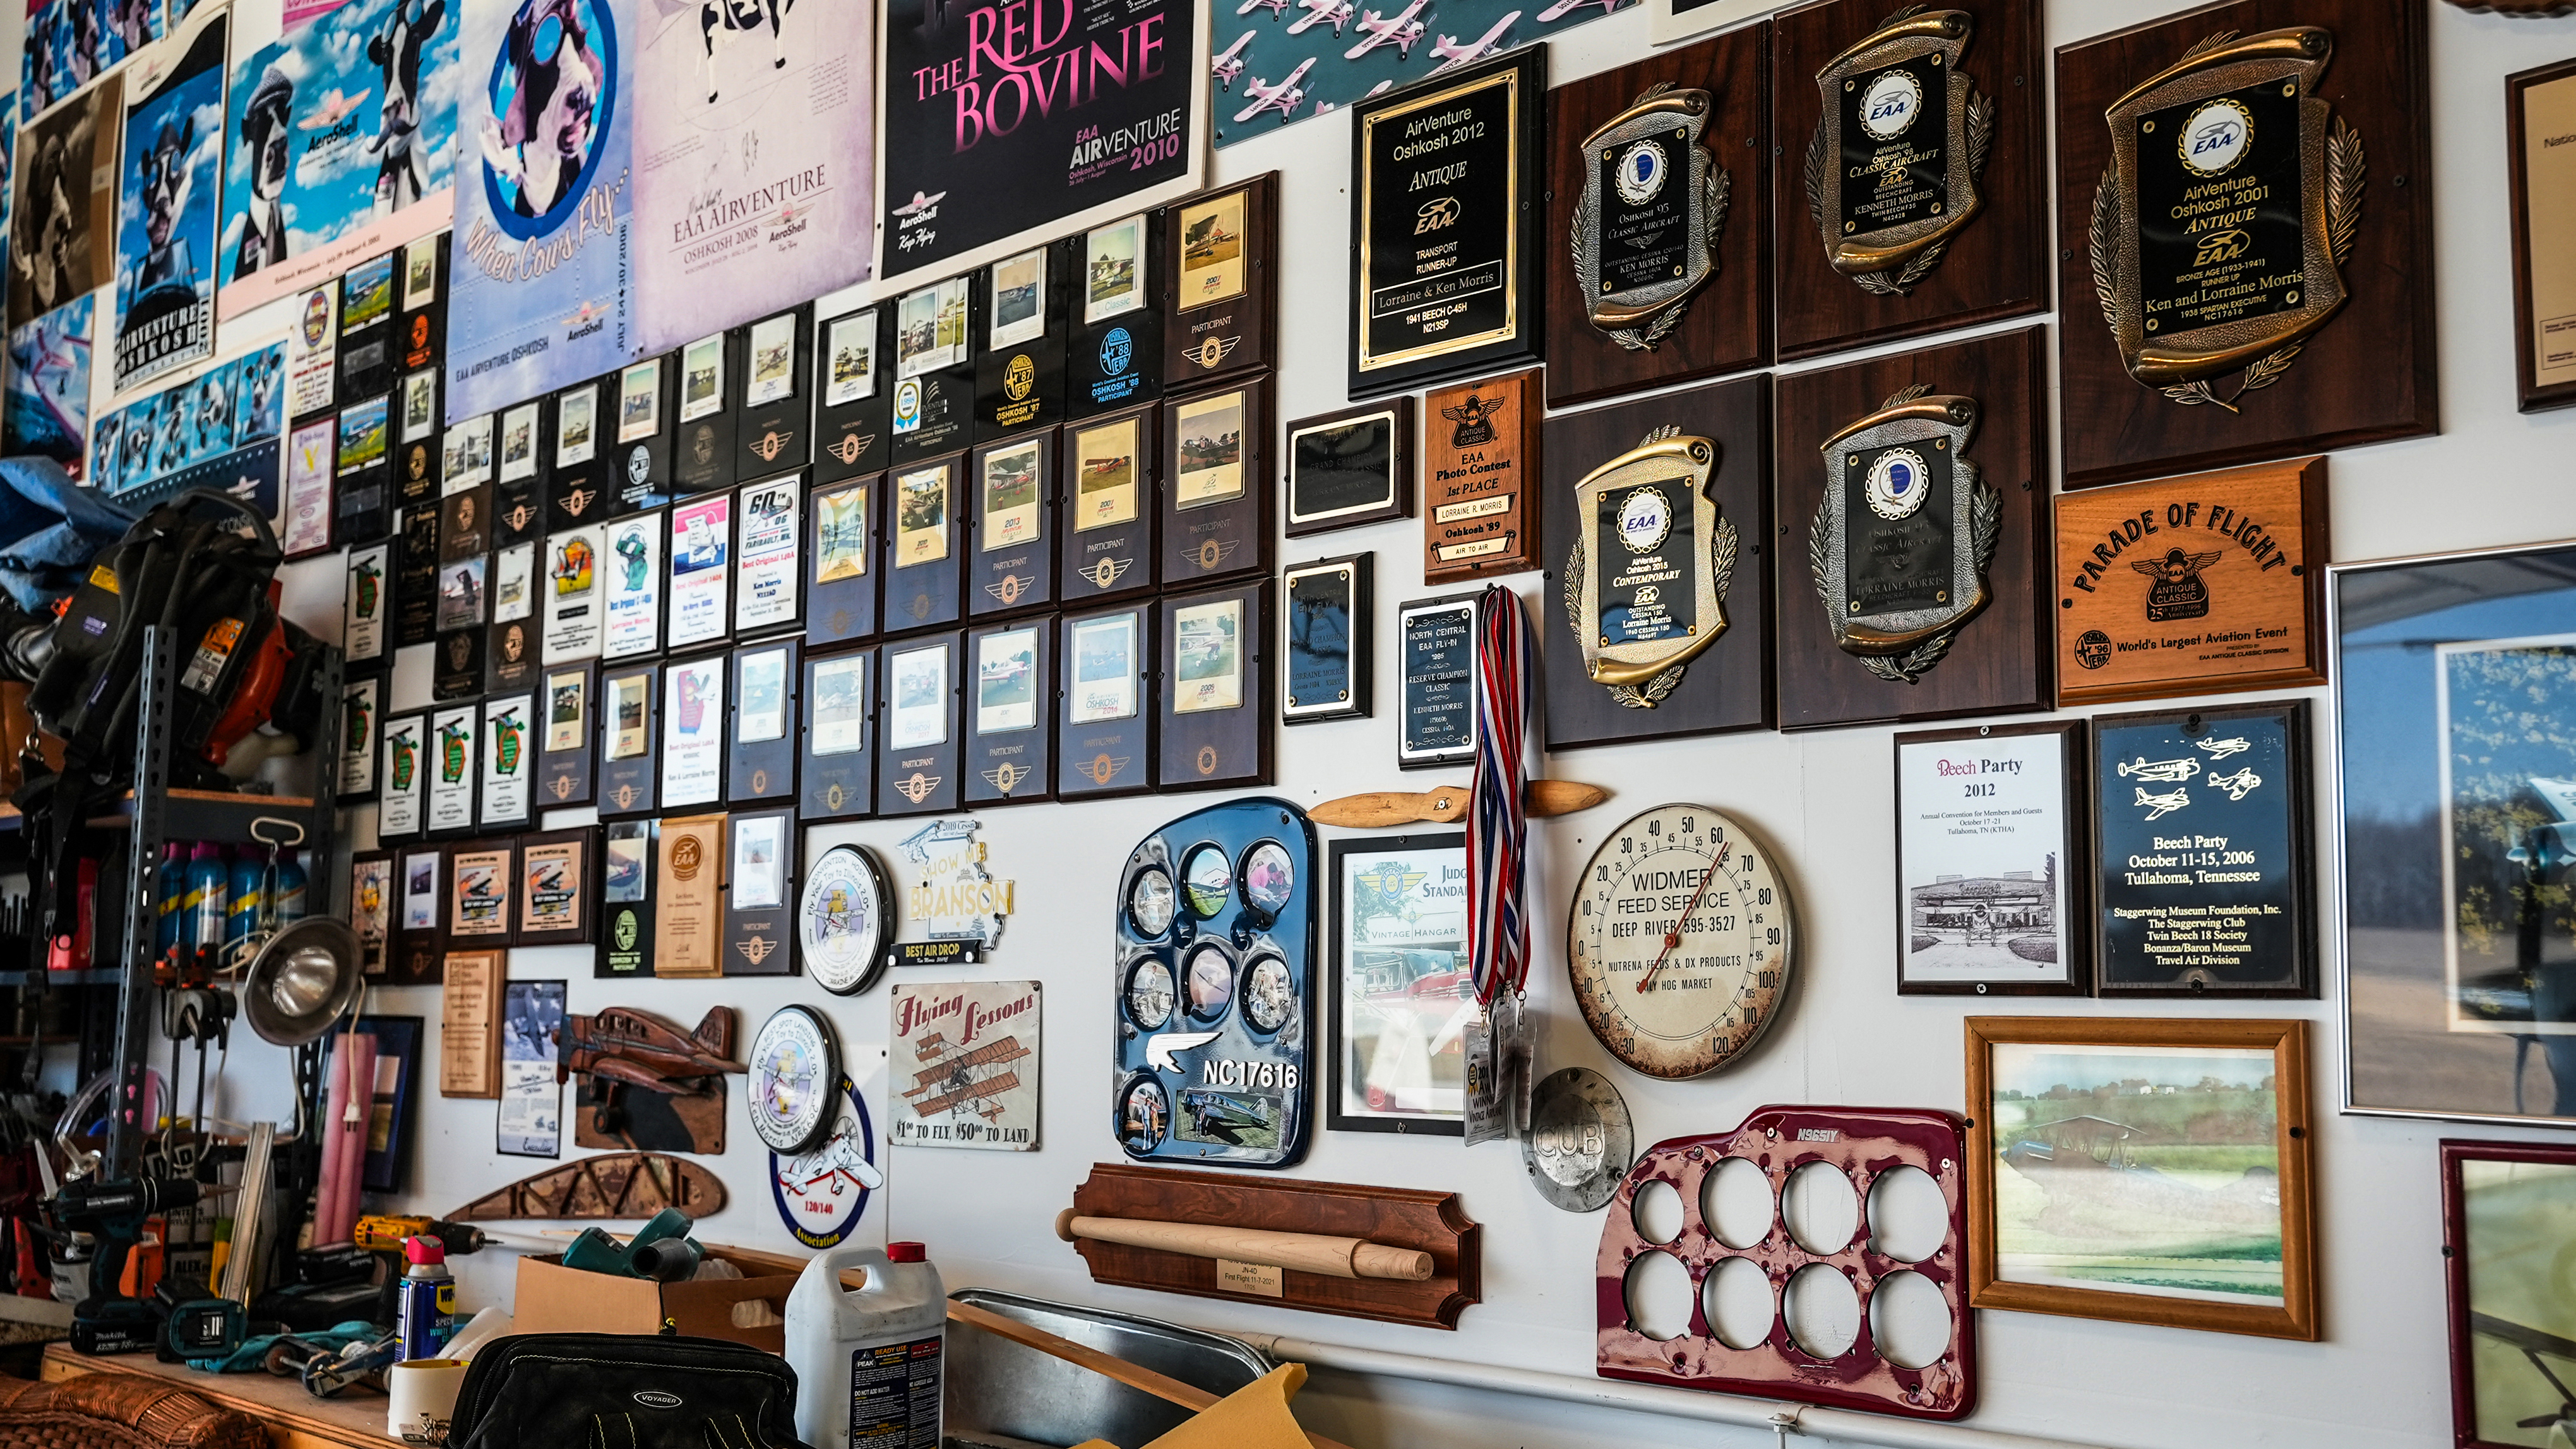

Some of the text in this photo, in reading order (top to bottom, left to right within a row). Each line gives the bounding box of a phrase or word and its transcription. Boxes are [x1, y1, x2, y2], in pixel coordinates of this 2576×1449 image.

[913, 0, 1075, 102] THE RED
[952, 12, 1165, 155] BOVINE
[1869, 102, 1905, 121] EAA
[1405, 107, 1472, 139] AirVenture
[307, 114, 359, 153] AeroShell
[1069, 107, 1181, 170] AIRVENTURE
[1075, 124, 1098, 144] EAA
[1393, 121, 1485, 162] Oshkosh 2012
[1130, 133, 1179, 172] 2010
[1875, 142, 1911, 155] AirVenture
[2192, 133, 2233, 155] EAA
[1097, 153, 1127, 170] Wisconsin
[1849, 149, 1940, 179] CLASSIC AIRCRAFT
[1872, 152, 1902, 164] Oshkosh
[2183, 175, 2257, 202] AirVenture
[673, 164, 826, 244] EAA AIRVENTURE
[1854, 189, 1934, 215] KENNETH MORRIS
[2171, 184, 2269, 220] Oshkosh 2001
[899, 206, 938, 230] AeroShell
[1414, 212, 1452, 236] EAA
[1640, 214, 1681, 232] AIRCRAFT
[768, 218, 808, 244] AeroShell
[466, 217, 516, 283] When
[520, 228, 578, 281] Cows
[684, 236, 733, 265] OSHKOSH
[736, 225, 758, 246] 2008
[1416, 241, 1458, 261] TRANSPORT
[1619, 254, 1669, 275] KEN MORRIS
[2192, 244, 2239, 267] EAA
[1416, 256, 1458, 275] RUNNER-UP
[2176, 258, 2265, 283] BRONZE AGE (1933-1941)
[1379, 271, 1494, 309] Lorraine Ken Morris
[2201, 273, 2241, 288] RUNNER UP
[2145, 269, 2305, 314] Ken and Lorraine Morris
[1405, 302, 1468, 325] 1941 BEECH C-45H
[2180, 294, 2267, 319] 1938 SPARTAN EXECUTIVE
[2203, 308, 2244, 323] NC17616
[119, 302, 199, 354] AIRVENTURE
[566, 318, 604, 343] AeroShell
[1423, 319, 1449, 333] N213SP
[616, 323, 625, 353] JULY
[119, 323, 198, 377] OSHKOSH
[511, 336, 549, 362] OSHKOSH
[1091, 381, 1126, 397] OSHKOSH
[1097, 388, 1133, 403] PARTICIPANT
[996, 406, 1029, 421] OSHKOSH
[1001, 414, 1034, 427] PARTICIPANT
[1461, 451, 1485, 465] EAA
[1436, 458, 1511, 481] Photo Contest
[1462, 478, 1500, 494] PLACE
[1441, 501, 1503, 518] LORRAINE MORRIS
[1445, 523, 1484, 539] Oshkosh
[1625, 513, 1655, 532] EAA
[1087, 538, 1125, 553] PARTICIPANT
[2073, 502, 2287, 594] PARADE OF FLIGHT
[993, 557, 1028, 571] PARTICIPANT
[1613, 569, 1681, 588] CONTEMPORARY
[2156, 583, 2197, 595] ANTIQUE
[2156, 592, 2197, 604] CLASSIC
[1622, 614, 1672, 629] Lorraine Morris
[1409, 625, 1467, 641] NORTH CENTRAL
[2117, 625, 2289, 653] World's Largest Aviation Event
[1418, 638, 1457, 652] EAA FLY-IN
[1086, 696, 1119, 709] OSHKOSH
[989, 745, 1024, 756] PARTICIPANT
[902, 757, 934, 768] PARTICIPANT
[1936, 757, 2024, 777] Beech Party
[1964, 783, 1996, 797] 2012
[1681, 816, 1695, 834] 50
[2153, 834, 2229, 851] Beech Party
[2128, 850, 2256, 869] October 11-15, 2006
[1631, 868, 1714, 892] WIDMER
[2124, 869, 2261, 886] Tullahoma, Tennessee
[910, 883, 1011, 919] BRANSON
[1616, 891, 1731, 915] FEED SERVICE
[2113, 904, 2262, 920] Staggerwing Museum Foundation,
[1371, 927, 1457, 939] VINTAGE HANGAR
[1611, 915, 1736, 938] DEEP RIVER 595-3527
[2147, 917, 2246, 931] The Staggerwing Club
[2146, 930, 2248, 943] Twin Beech Society
[905, 943, 960, 958] BEST AIR DROP
[1661, 977, 1714, 992] HOG MARKET
[896, 991, 1035, 1046] Flying Lessons
[1203, 1059, 1298, 1089] NC17616
[915, 1123, 928, 1139] TO
[1003, 1126, 1030, 1143] LAND
[1535, 1124, 1603, 1157] CUB
[804, 1200, 833, 1215] 120/140
[795, 1227, 840, 1248] Association
[1237, 1274, 1249, 1283] Flight
[641, 1394, 677, 1405] VOYAGER
